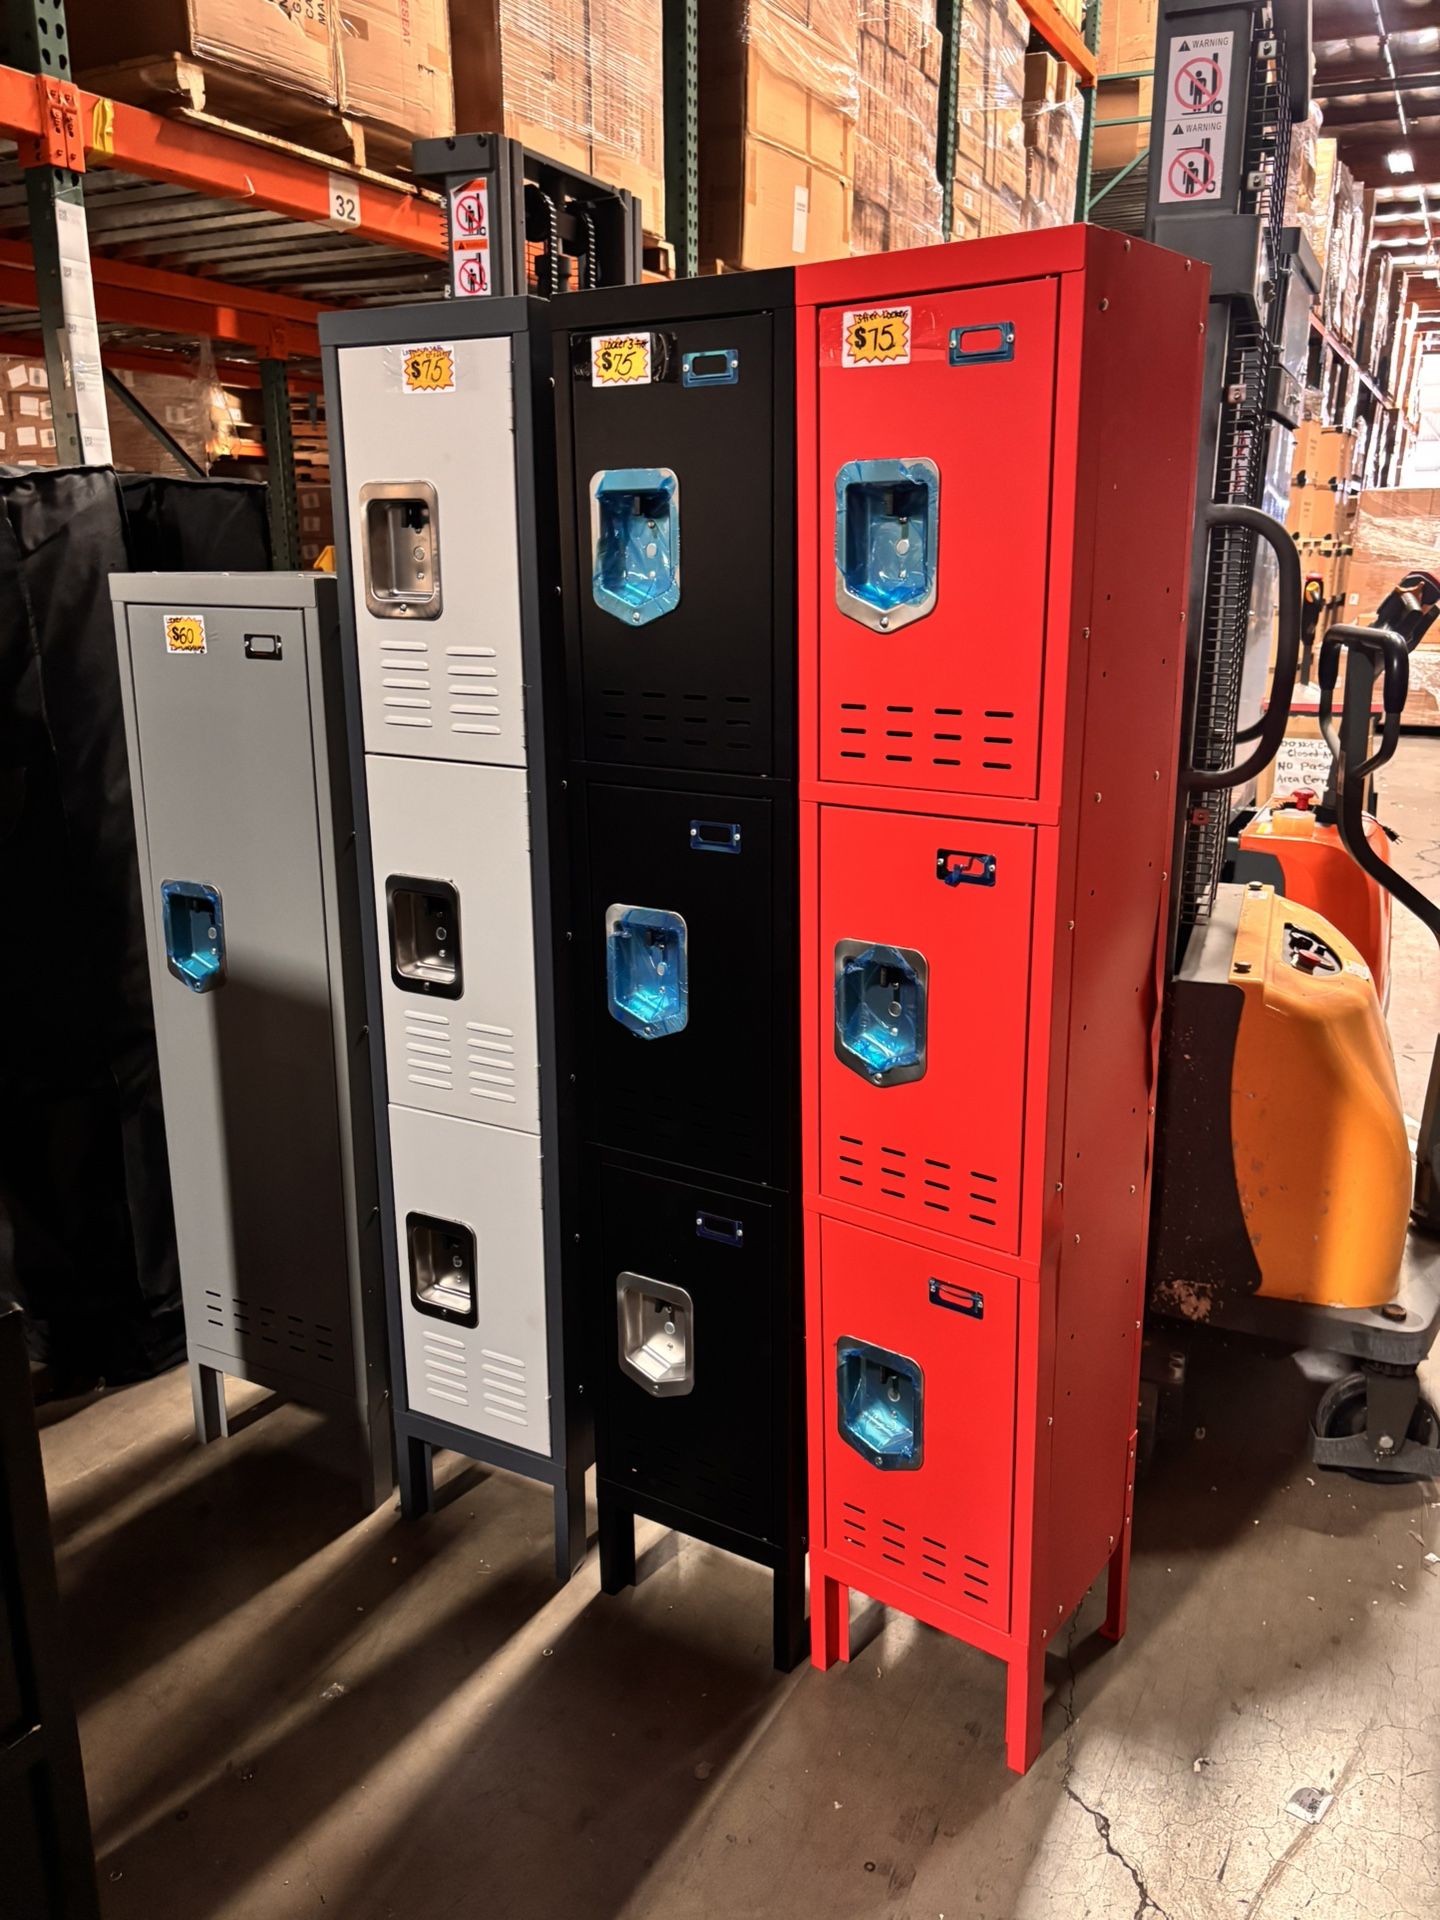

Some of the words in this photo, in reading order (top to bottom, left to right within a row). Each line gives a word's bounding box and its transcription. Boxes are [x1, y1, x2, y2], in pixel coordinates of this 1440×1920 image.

[1192, 37, 1229, 49] WARNING
[1186, 122, 1222, 133] WARNING
[336, 194, 356, 221] 32
[854, 323, 895, 352] $75
[411, 357, 445, 383] $75
[602, 351, 636, 376] $75
[172, 626, 194, 645] $60
[1277, 761, 1293, 771] NO
[1277, 774, 1300, 784] Area
